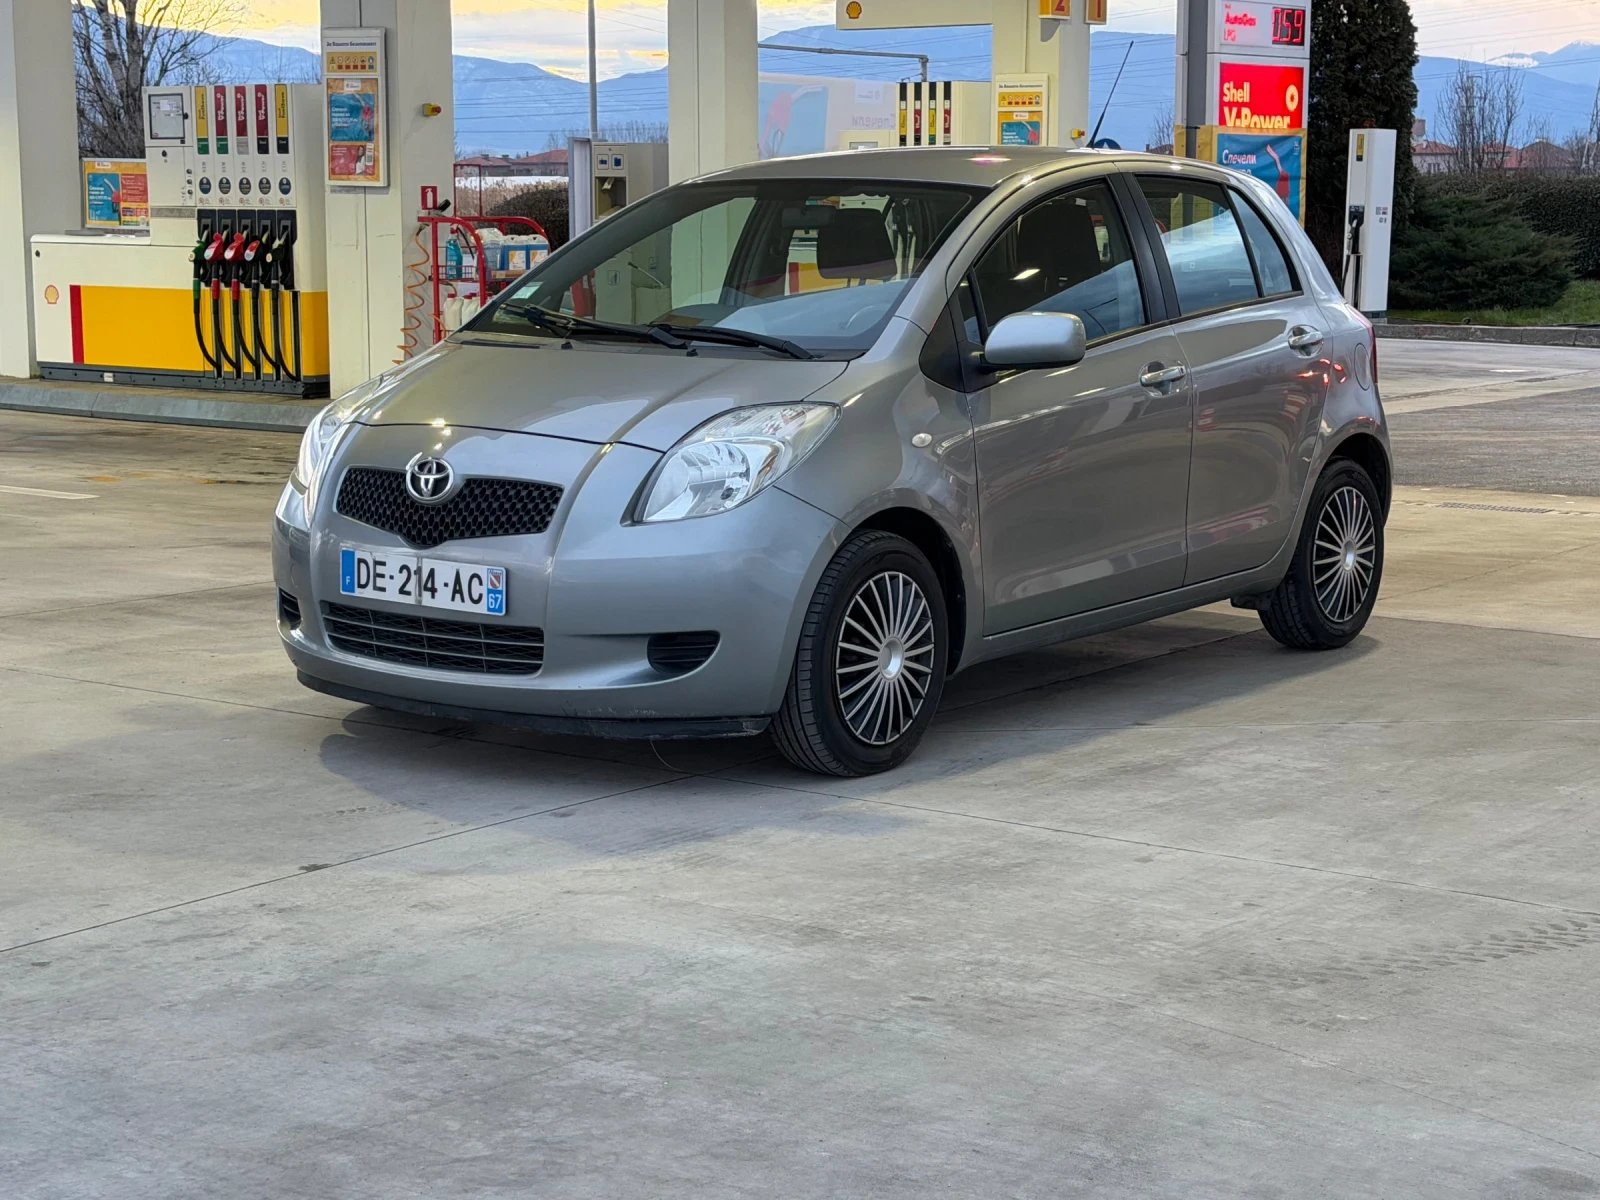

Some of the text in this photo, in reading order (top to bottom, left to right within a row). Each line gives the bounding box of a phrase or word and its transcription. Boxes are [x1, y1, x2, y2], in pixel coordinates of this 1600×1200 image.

[1223, 81, 1250, 103] Shell
[1223, 106, 1291, 129] V-Power
[1222, 149, 1257, 165] Спечели
[345, 576, 351, 585] F
[488, 593, 502, 609] 67
